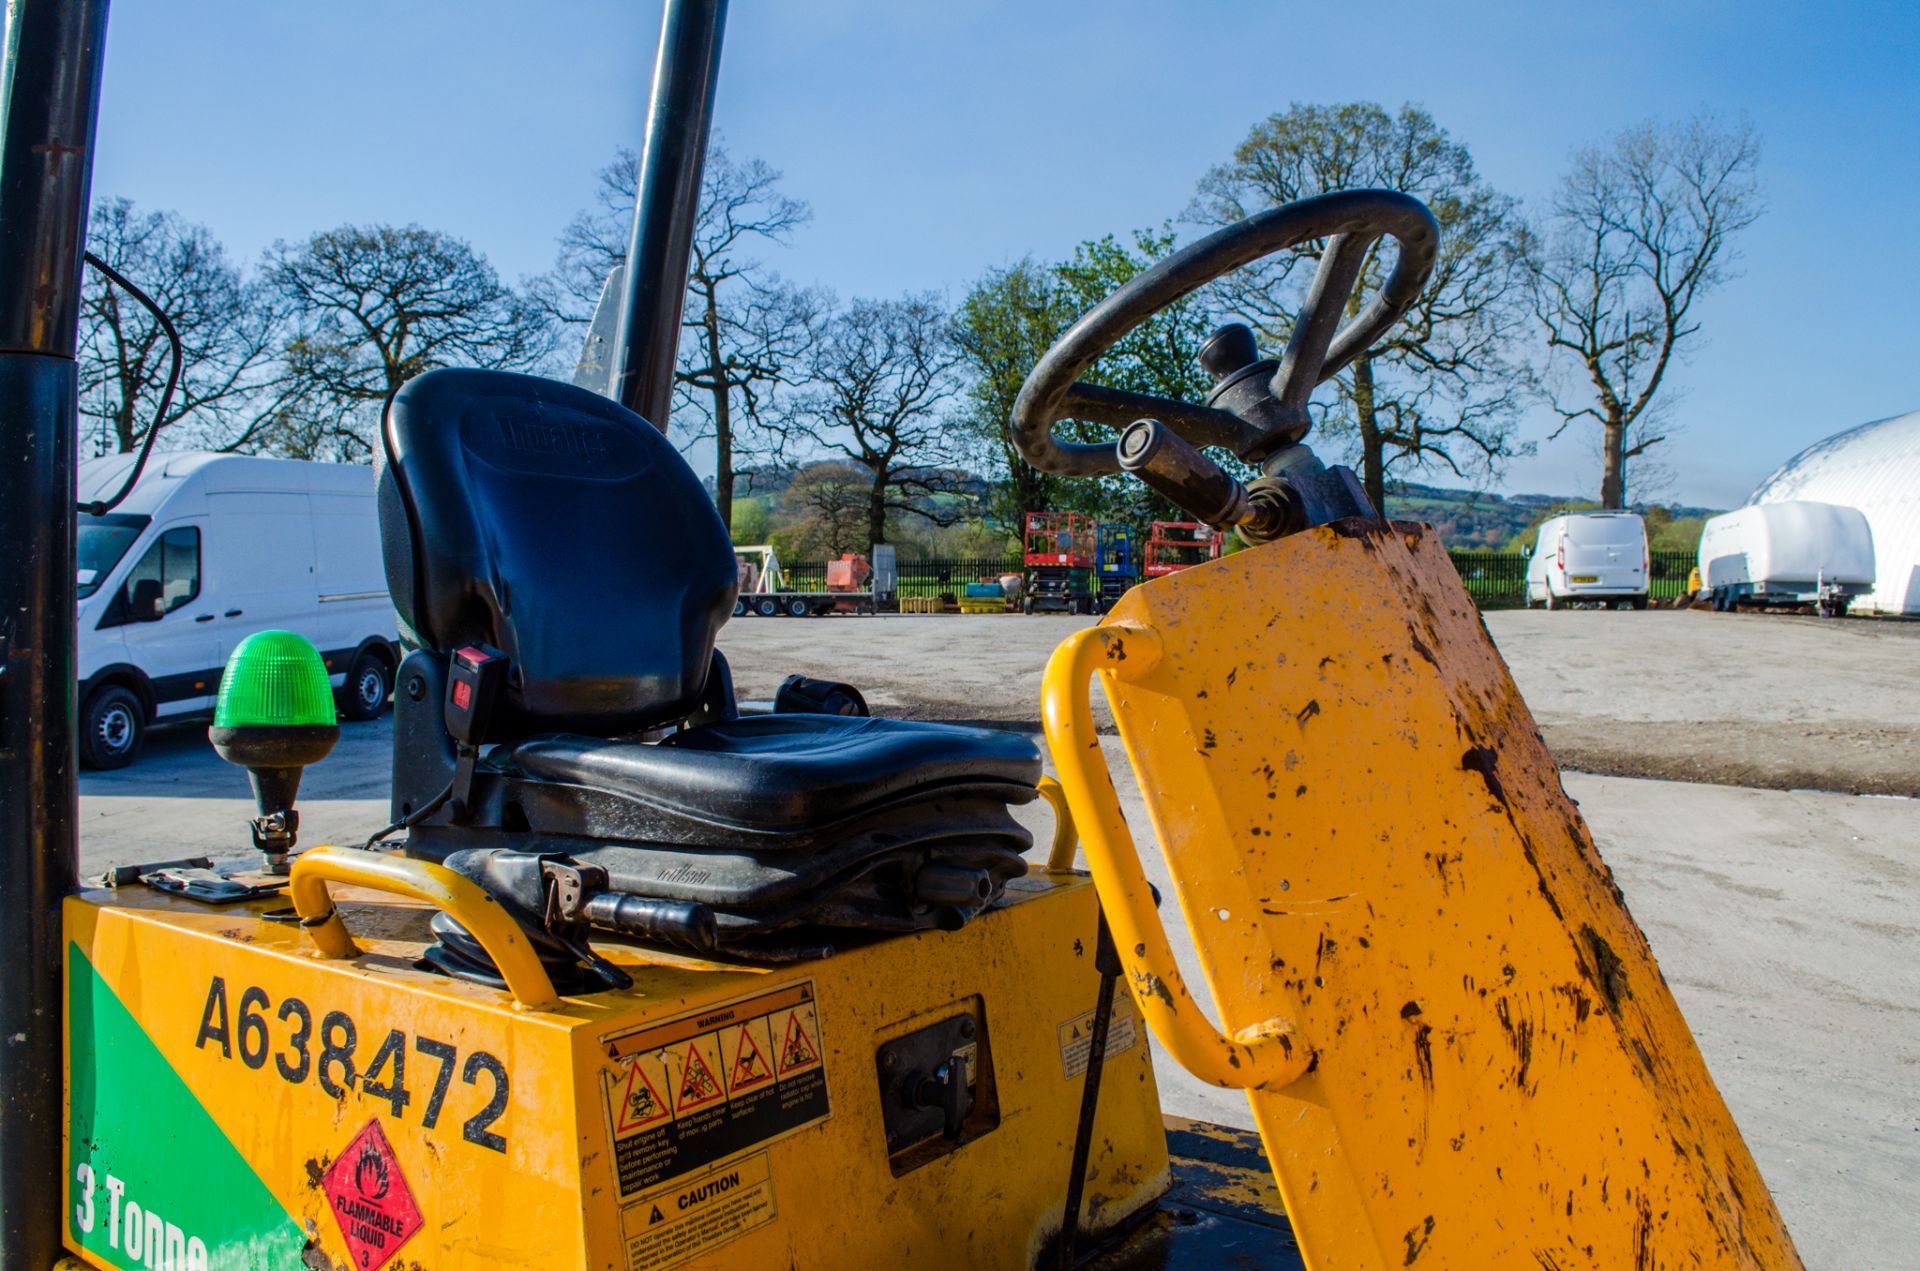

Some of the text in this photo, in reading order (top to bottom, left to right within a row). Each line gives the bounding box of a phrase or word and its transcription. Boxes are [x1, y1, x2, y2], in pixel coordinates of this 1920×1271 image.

[696, 1010, 735, 1028] WARNING
[195, 976, 510, 1154] A638472
[677, 1119, 693, 1132] Keep
[708, 1117, 723, 1130] parts
[617, 1128, 666, 1152] Shut engine off
[632, 1143, 657, 1157] remove
[657, 1138, 670, 1150] key
[619, 1145, 678, 1173] before performing
[621, 1157, 671, 1182] maintenance or
[76, 1162, 95, 1233] 3
[622, 1178, 642, 1193] repair
[678, 1172, 740, 1210] CAUTION
[337, 1195, 403, 1237] FLAMMABLE
[351, 1220, 386, 1249] LIQUID
[630, 1240, 641, 1250] DO
[640, 1235, 653, 1246] NOT
[362, 1250, 371, 1268] 3
